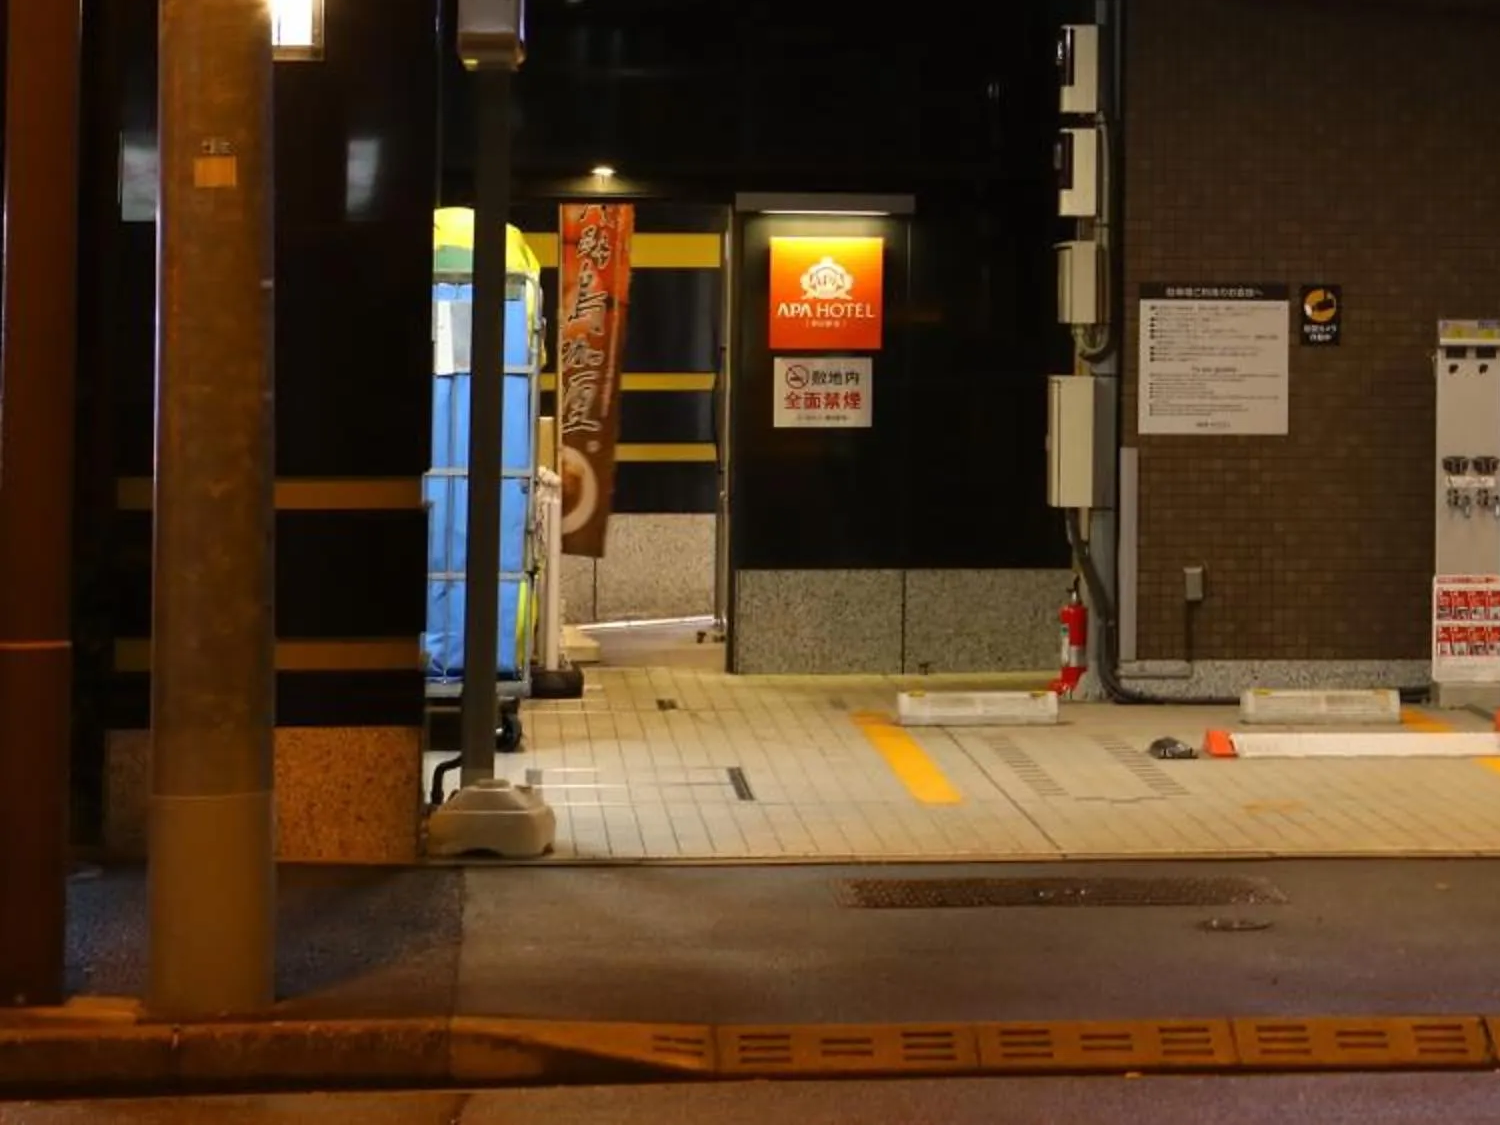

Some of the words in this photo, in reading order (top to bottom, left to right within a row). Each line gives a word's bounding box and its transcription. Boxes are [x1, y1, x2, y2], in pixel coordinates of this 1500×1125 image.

[777, 302, 813, 318] APA
[816, 303, 875, 319] HOTEL
[811, 370, 861, 387] 敷地内
[783, 390, 862, 411] 全面禁煙
